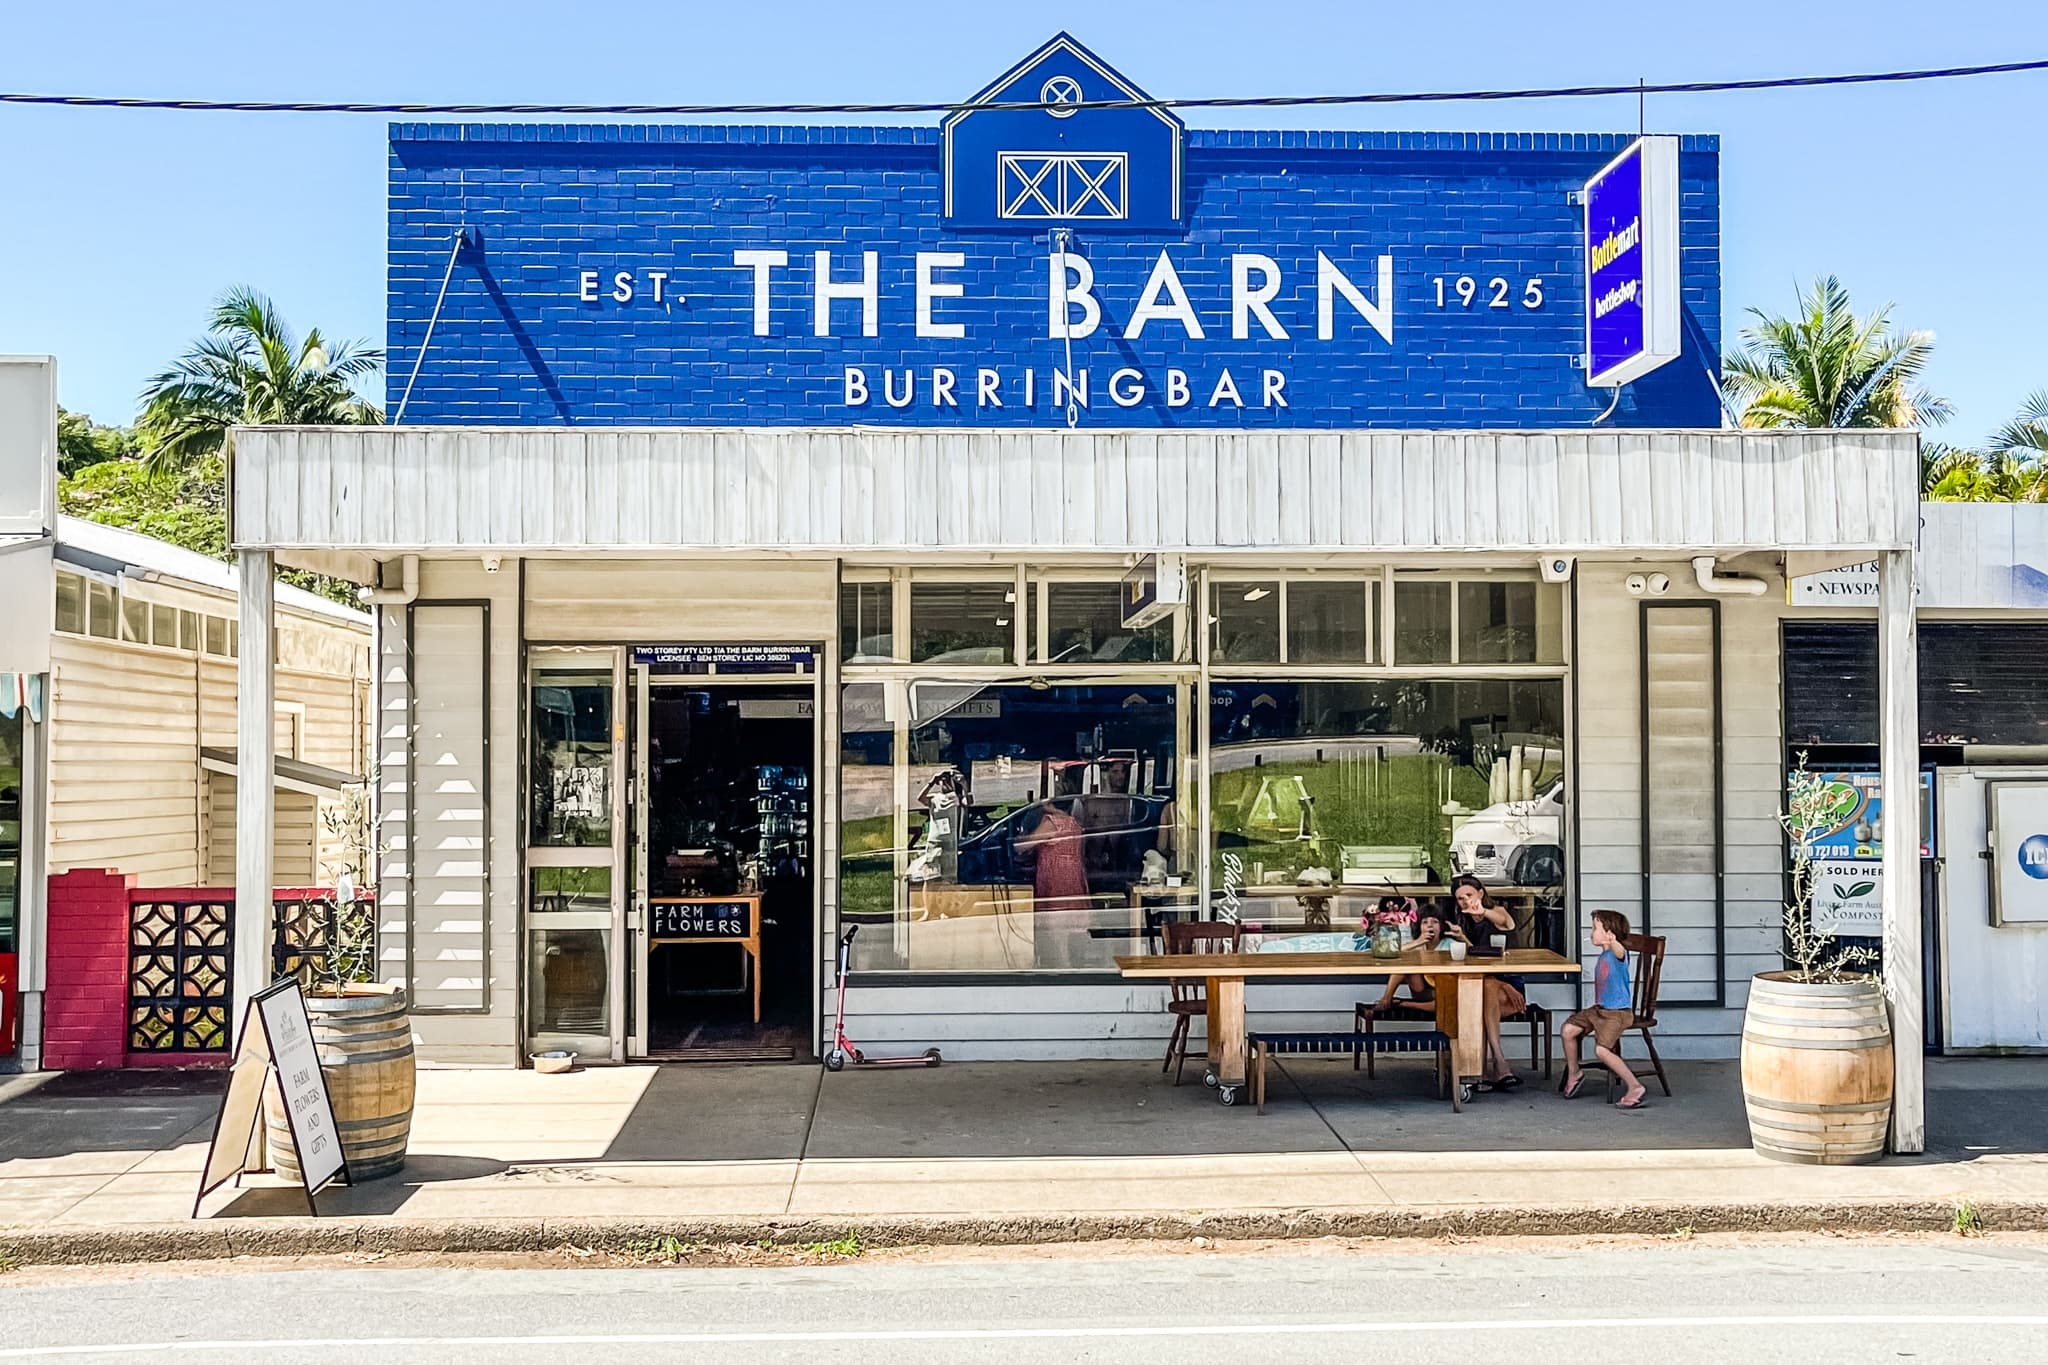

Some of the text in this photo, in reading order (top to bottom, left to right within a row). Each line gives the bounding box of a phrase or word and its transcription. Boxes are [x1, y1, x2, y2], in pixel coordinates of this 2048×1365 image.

[1591, 215, 1640, 274] Bottlemart
[580, 247, 1544, 346] EST. THE BARN 1925
[1595, 278, 1637, 319] bottleshop
[845, 366, 1289, 410] BURRINGBAR
[636, 647, 653, 655] TWO
[654, 646, 682, 655] STOREY
[683, 646, 698, 655] PTY
[698, 647, 713, 655] LTD
[726, 646, 740, 654] THE
[741, 646, 762, 654] BARN
[656, 654, 691, 662] LICENSEE
[712, 654, 741, 662] STOREY
[742, 654, 754, 662] LIC
[797, 702, 814, 713] FA
[1814, 845, 1831, 857] 727
[1832, 845, 1850, 857] 013
[1827, 866, 1883, 877] SOLD HER
[655, 905, 704, 918] FARM
[655, 919, 742, 934] FLOWERS
[292, 1067, 311, 1089] FARM
[293, 1086, 321, 1115] FLOWERS
[307, 1112, 321, 1133] AND
